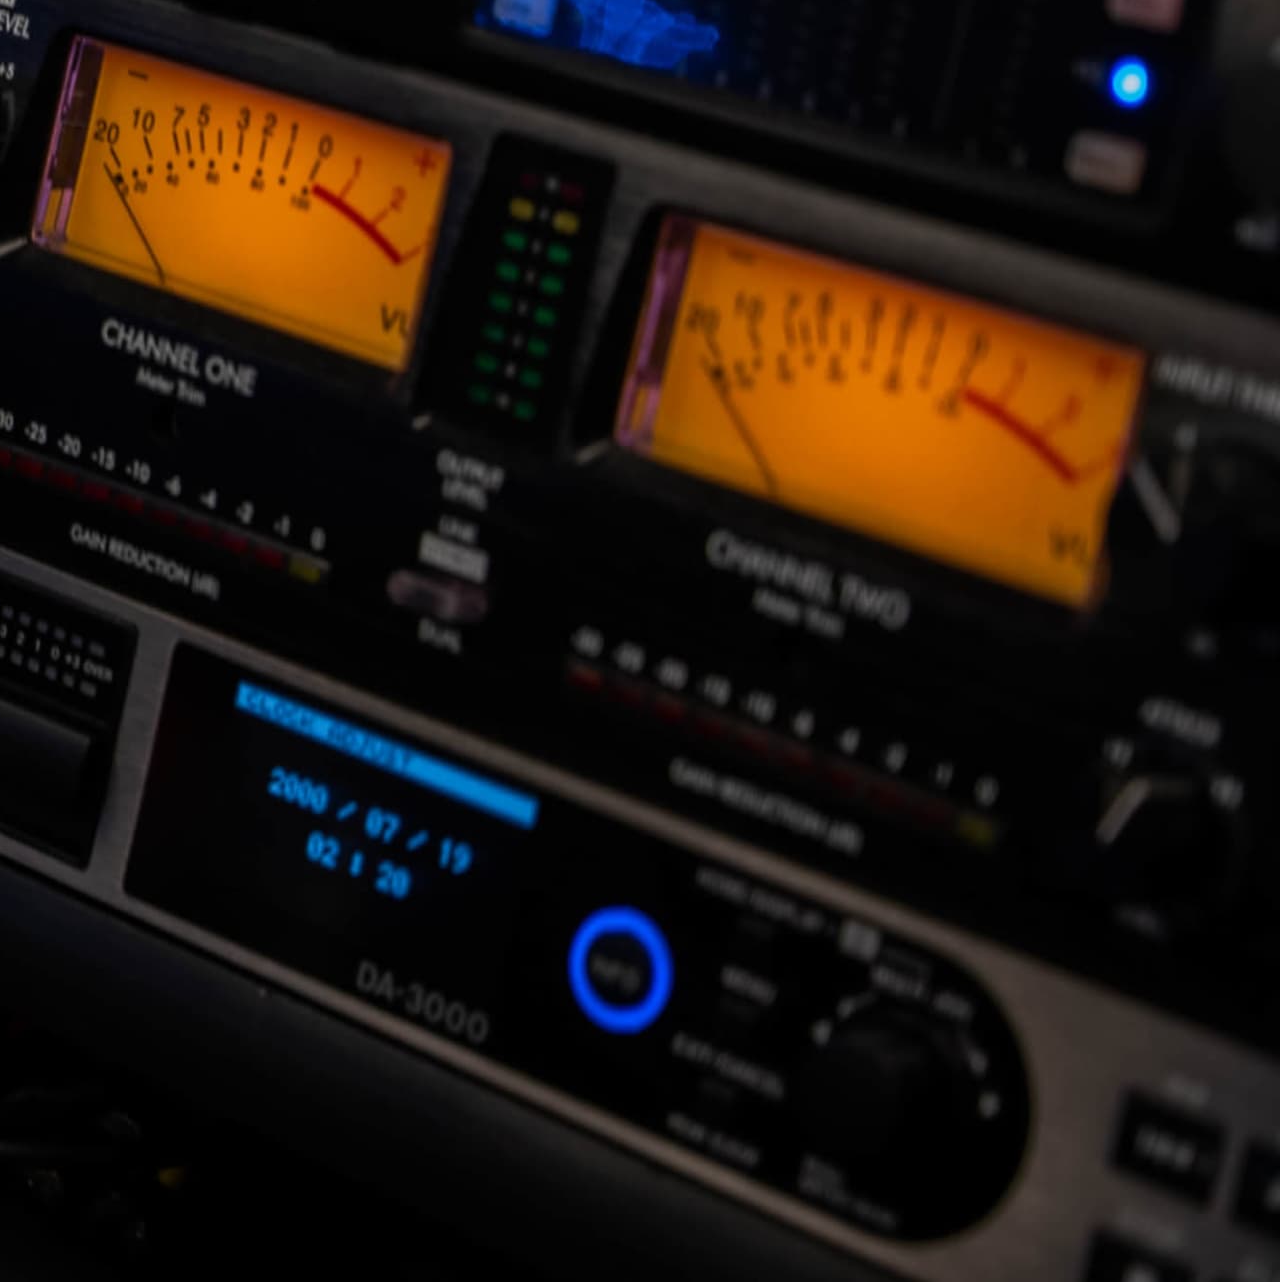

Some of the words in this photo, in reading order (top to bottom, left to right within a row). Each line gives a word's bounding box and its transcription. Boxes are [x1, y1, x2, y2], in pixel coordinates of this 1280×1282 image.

[92, 118, 121, 145] 20
[132, 106, 156, 134] 10
[171, 104, 186, 129] 7
[195, 102, 210, 128] 5
[236, 106, 251, 132] 3
[262, 111, 278, 137] 2
[318, 133, 334, 159] 0
[100, 316, 201, 379] CHANNEL
[203, 354, 259, 399] ONE
[69, 521, 108, 555] GAIN
[107, 535, 191, 587] REDUCTION
[266, 765, 329, 815] 2000
[305, 829, 341, 870] 02
[373, 858, 412, 902] 20
[355, 959, 490, 1046] DA-3000
